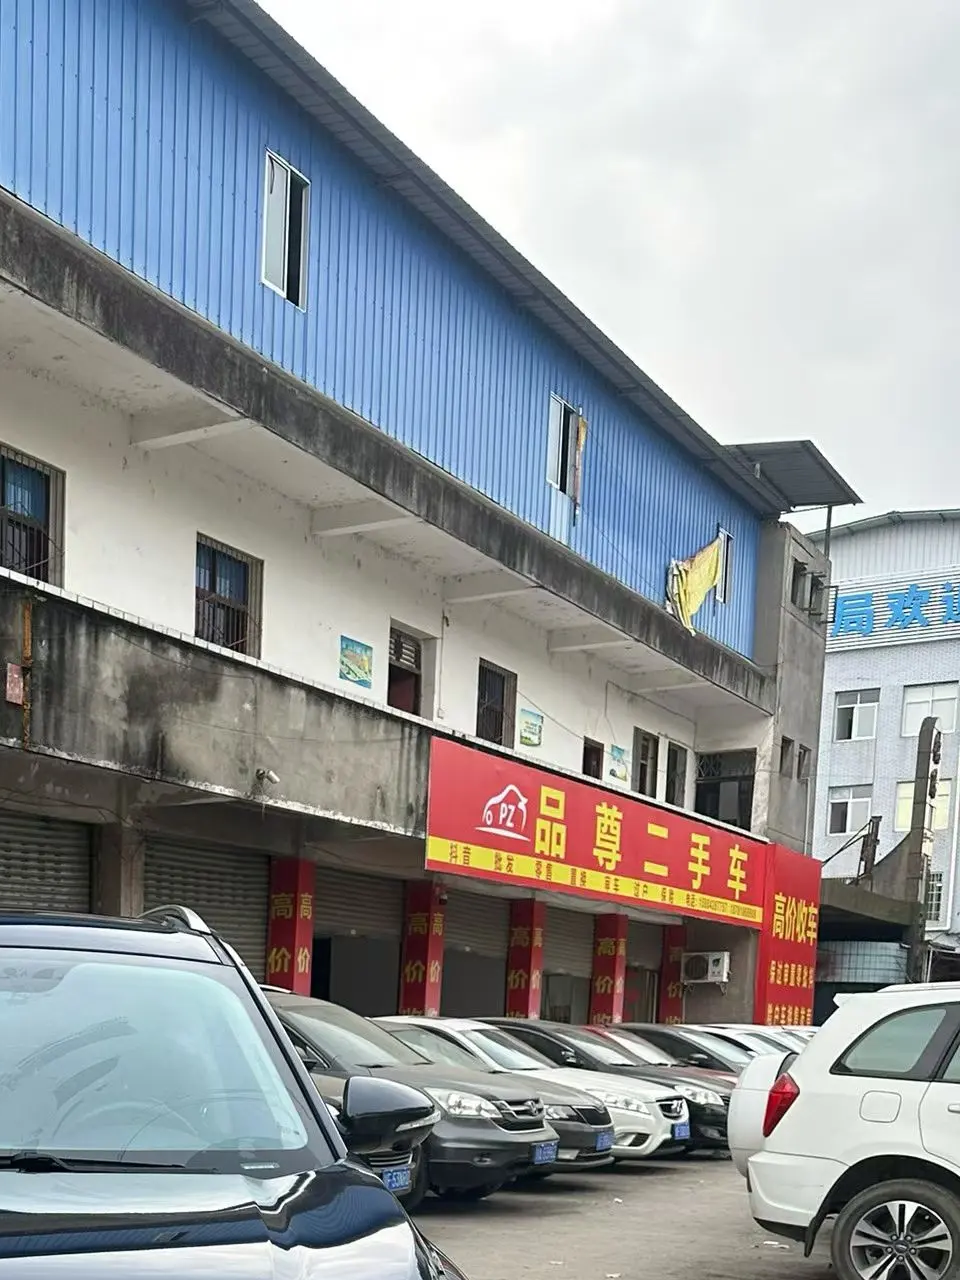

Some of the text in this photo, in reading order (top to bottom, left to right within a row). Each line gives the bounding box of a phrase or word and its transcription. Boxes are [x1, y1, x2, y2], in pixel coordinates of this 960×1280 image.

[534, 784, 748, 900] 品尊二手车
[772, 892, 818, 946] 高价收车
